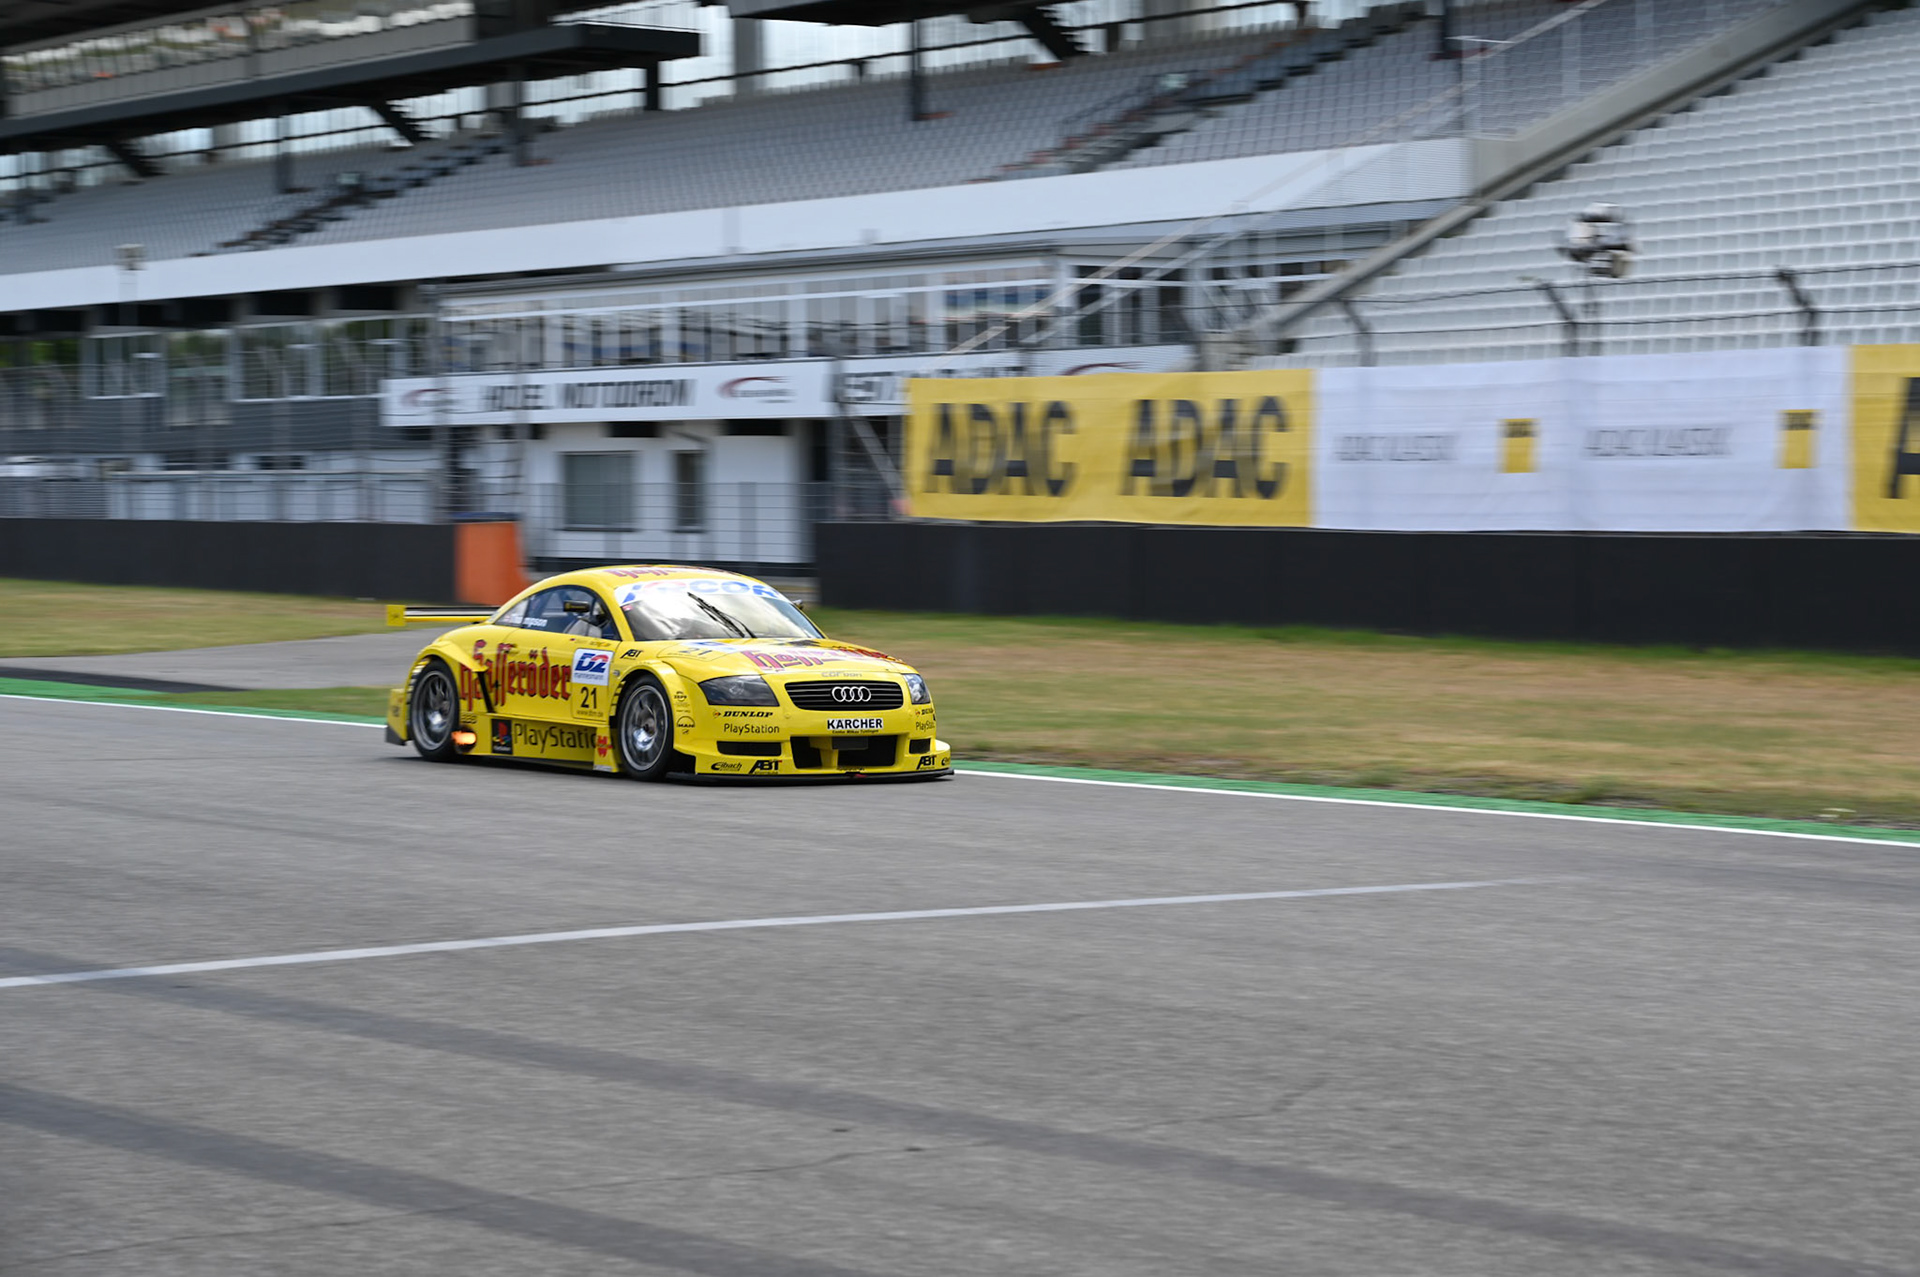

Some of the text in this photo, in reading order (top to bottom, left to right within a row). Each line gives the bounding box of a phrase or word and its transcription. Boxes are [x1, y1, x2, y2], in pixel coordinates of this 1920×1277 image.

[925, 399, 1079, 498] ADAC
[1119, 396, 1292, 500] ADAC
[574, 652, 610, 674] D2
[580, 686, 598, 710] 21
[723, 710, 773, 718] DUNLOP
[723, 723, 780, 736] PlayStation
[748, 759, 783, 775] ABT
[915, 755, 938, 770] ABT
